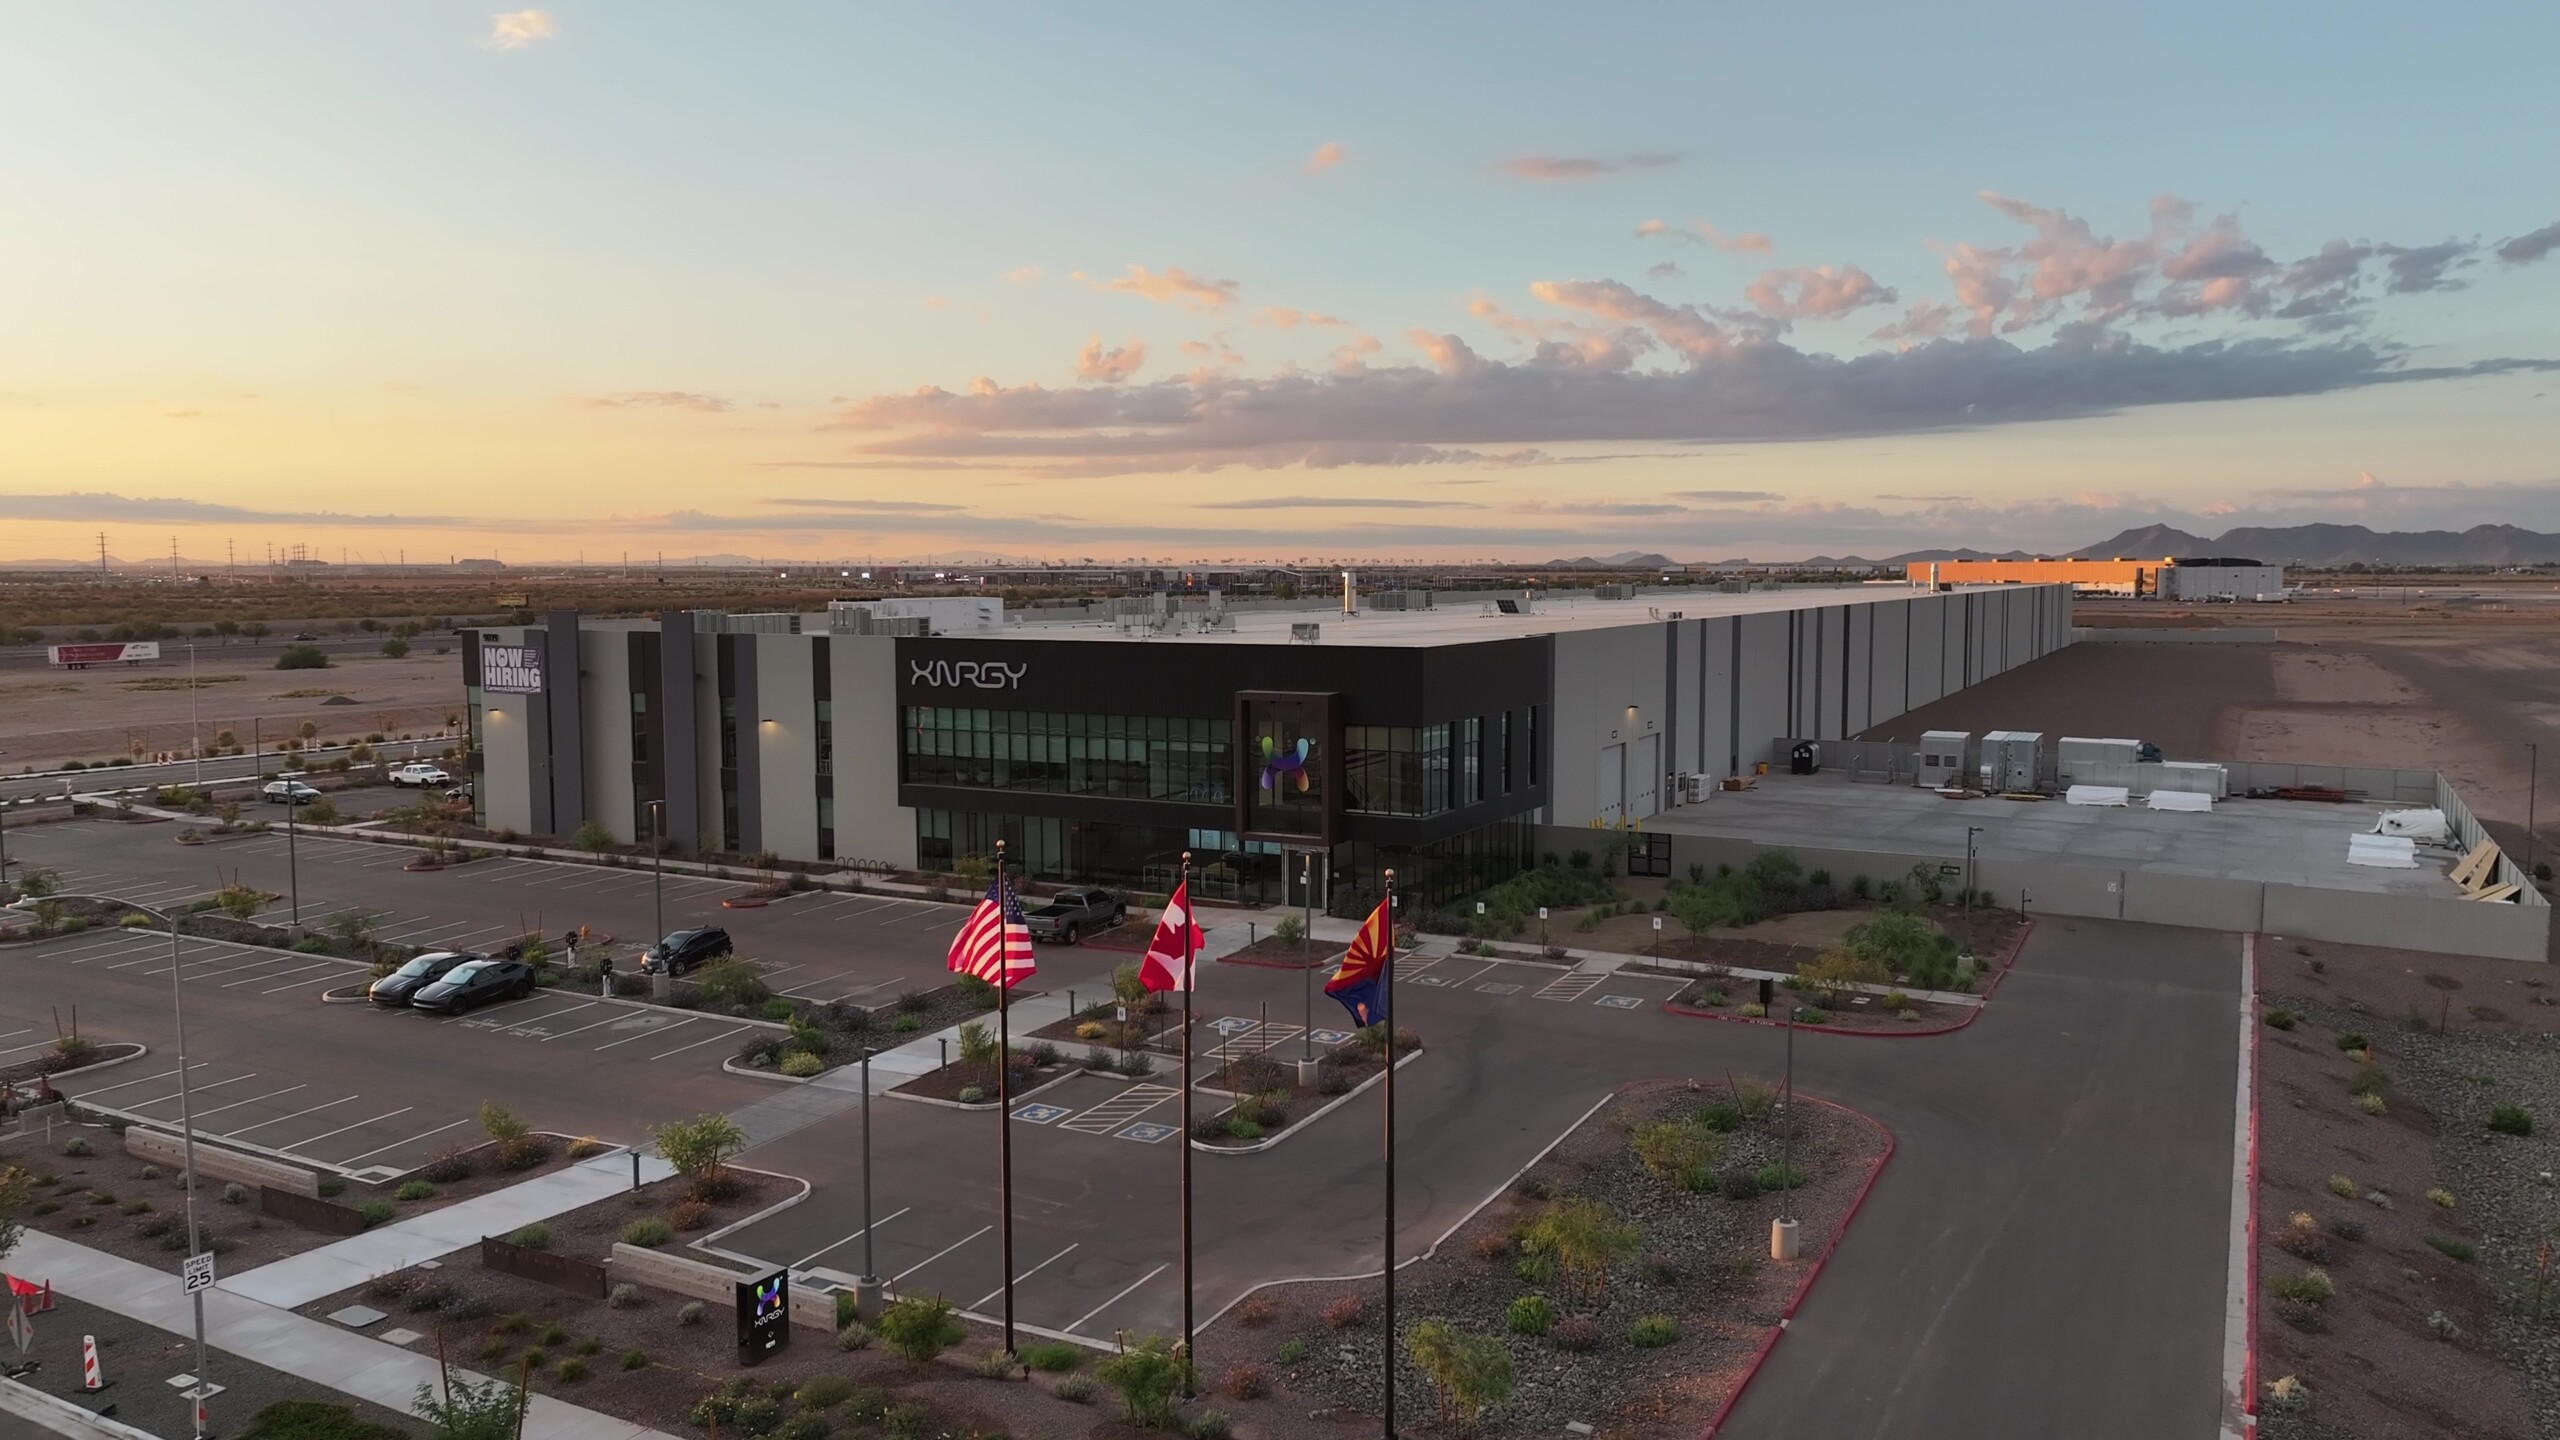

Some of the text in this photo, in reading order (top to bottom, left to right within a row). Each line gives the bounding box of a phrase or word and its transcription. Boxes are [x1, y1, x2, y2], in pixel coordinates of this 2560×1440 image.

[484, 647, 522, 667] NOW
[485, 667, 541, 687] HIRING
[911, 660, 1027, 689] XNRGY
[185, 1255, 212, 1269] SPEED
[188, 1263, 209, 1275] LIMIT
[187, 1270, 211, 1290] 25
[754, 1306, 785, 1328] XNRGY
